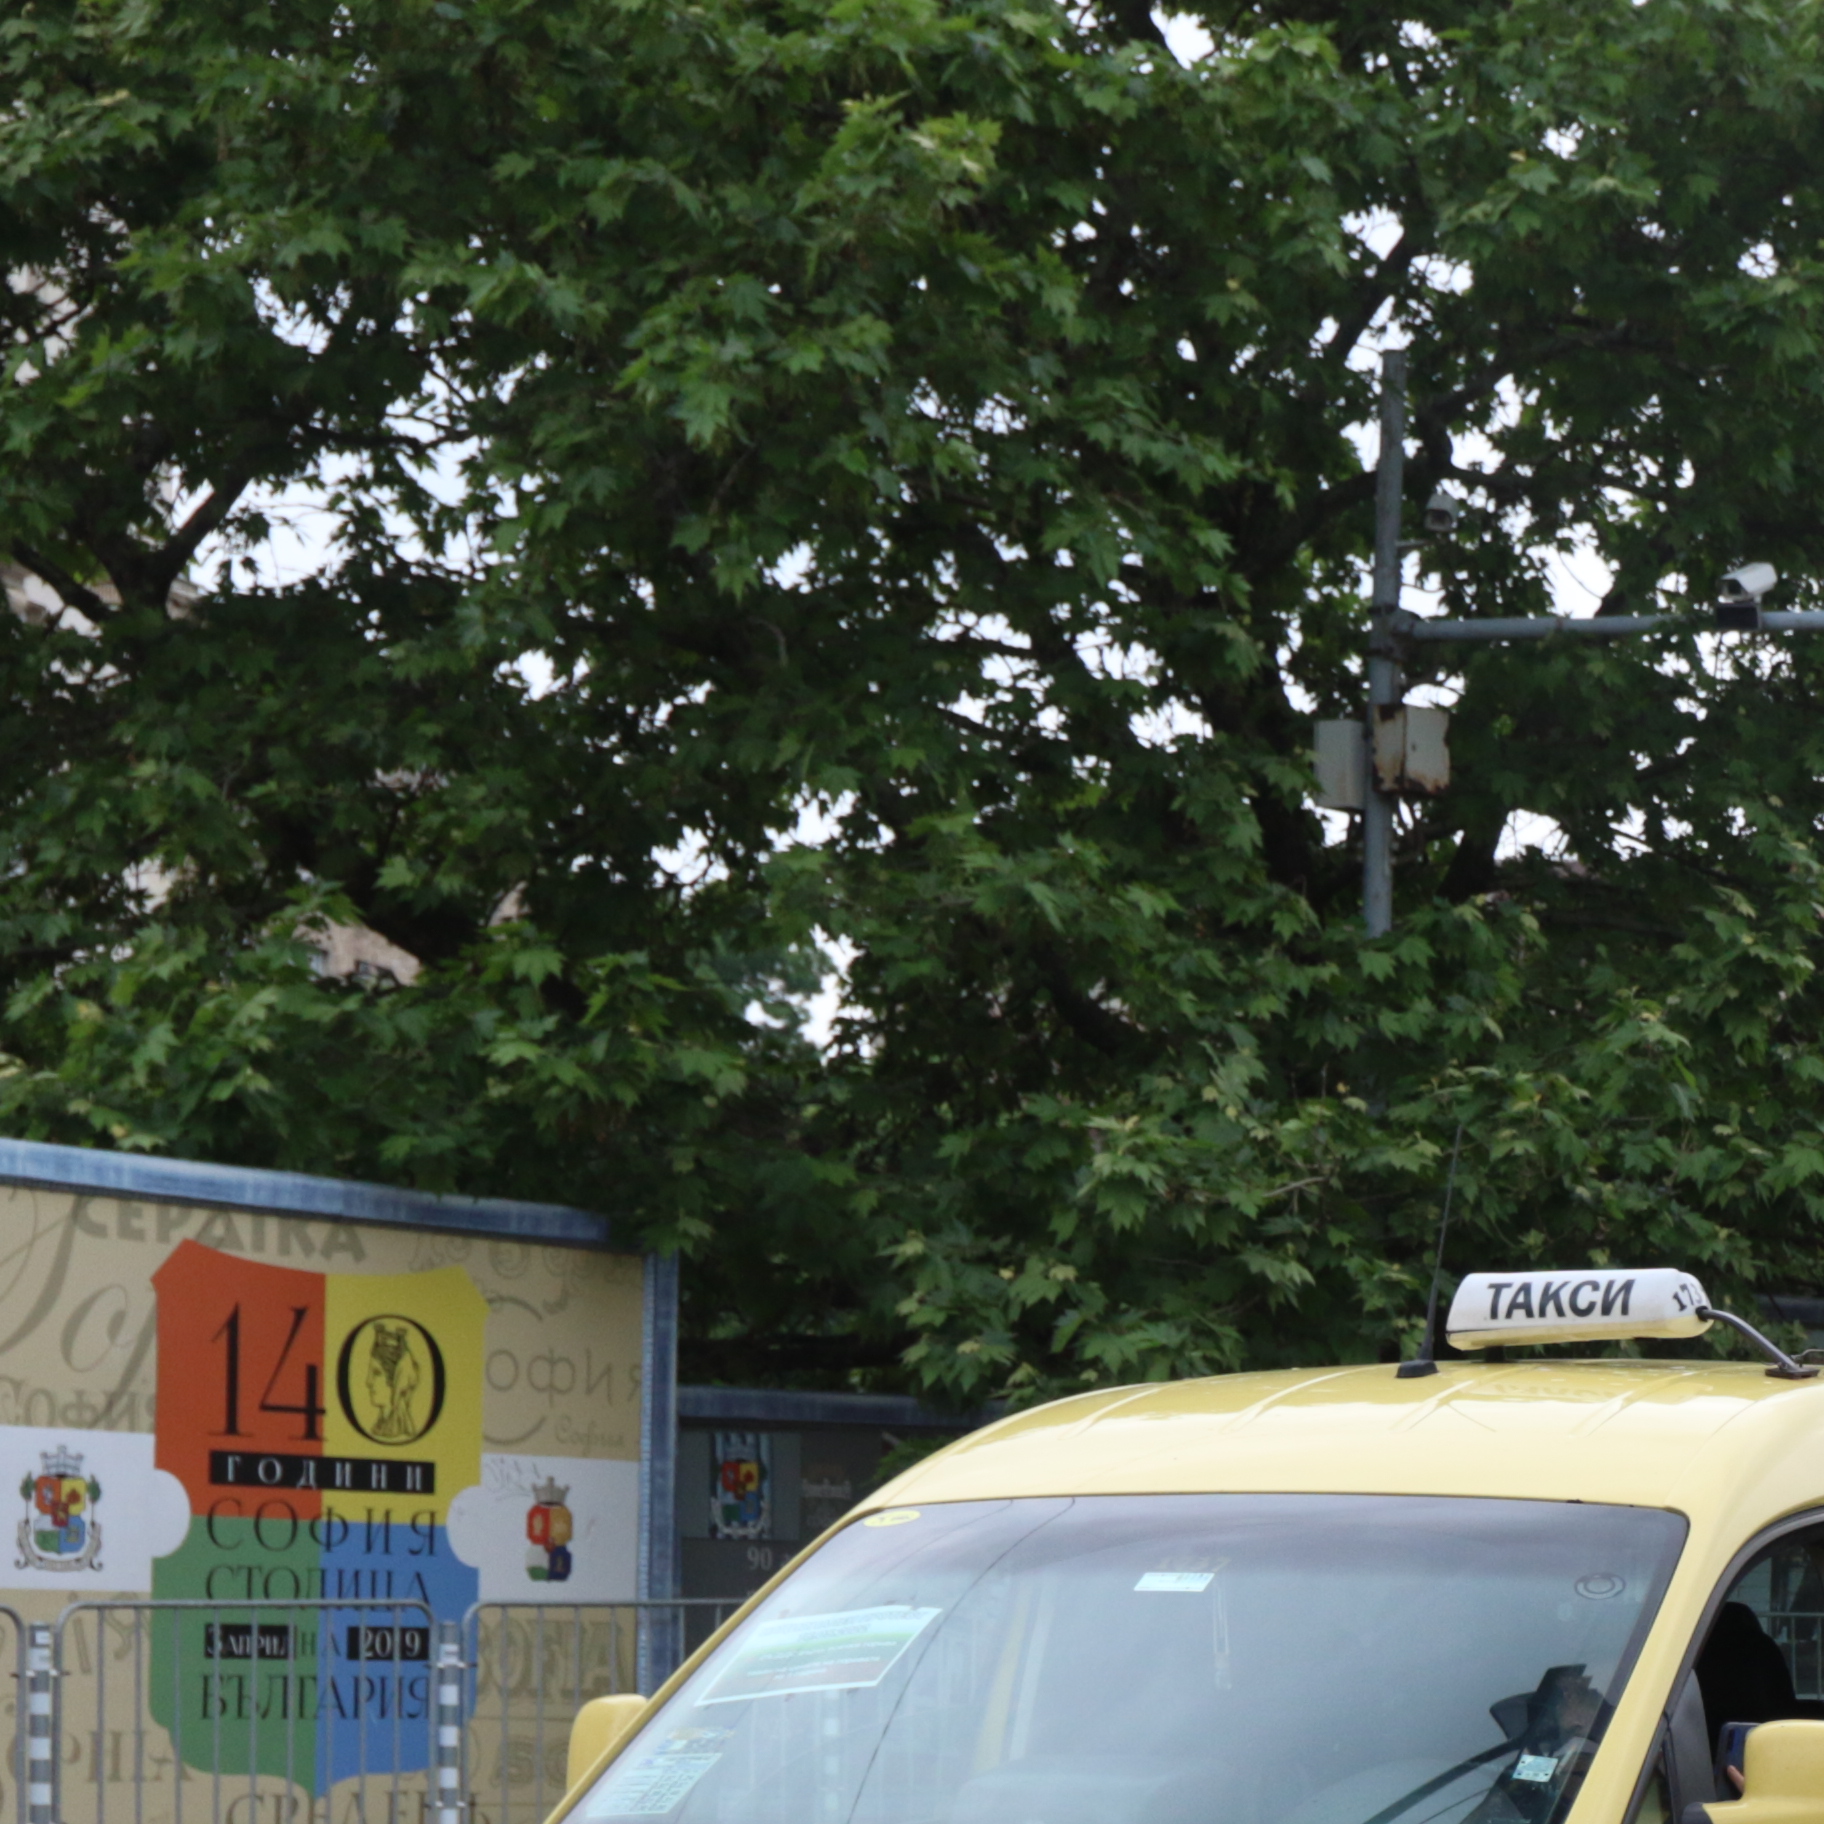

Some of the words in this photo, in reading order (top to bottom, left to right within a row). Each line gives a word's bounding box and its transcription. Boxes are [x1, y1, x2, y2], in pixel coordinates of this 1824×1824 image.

[1487, 1278, 1635, 1320] ТАКСИ
[208, 1303, 445, 1445] 140
[227, 1455, 423, 1492] ГОДИНИ
[207, 1497, 438, 1557] СОФИЯ
[206, 1564, 430, 1612] СТОЛИЦА
[202, 1675, 430, 1721] БЪЛГАРИЯ
